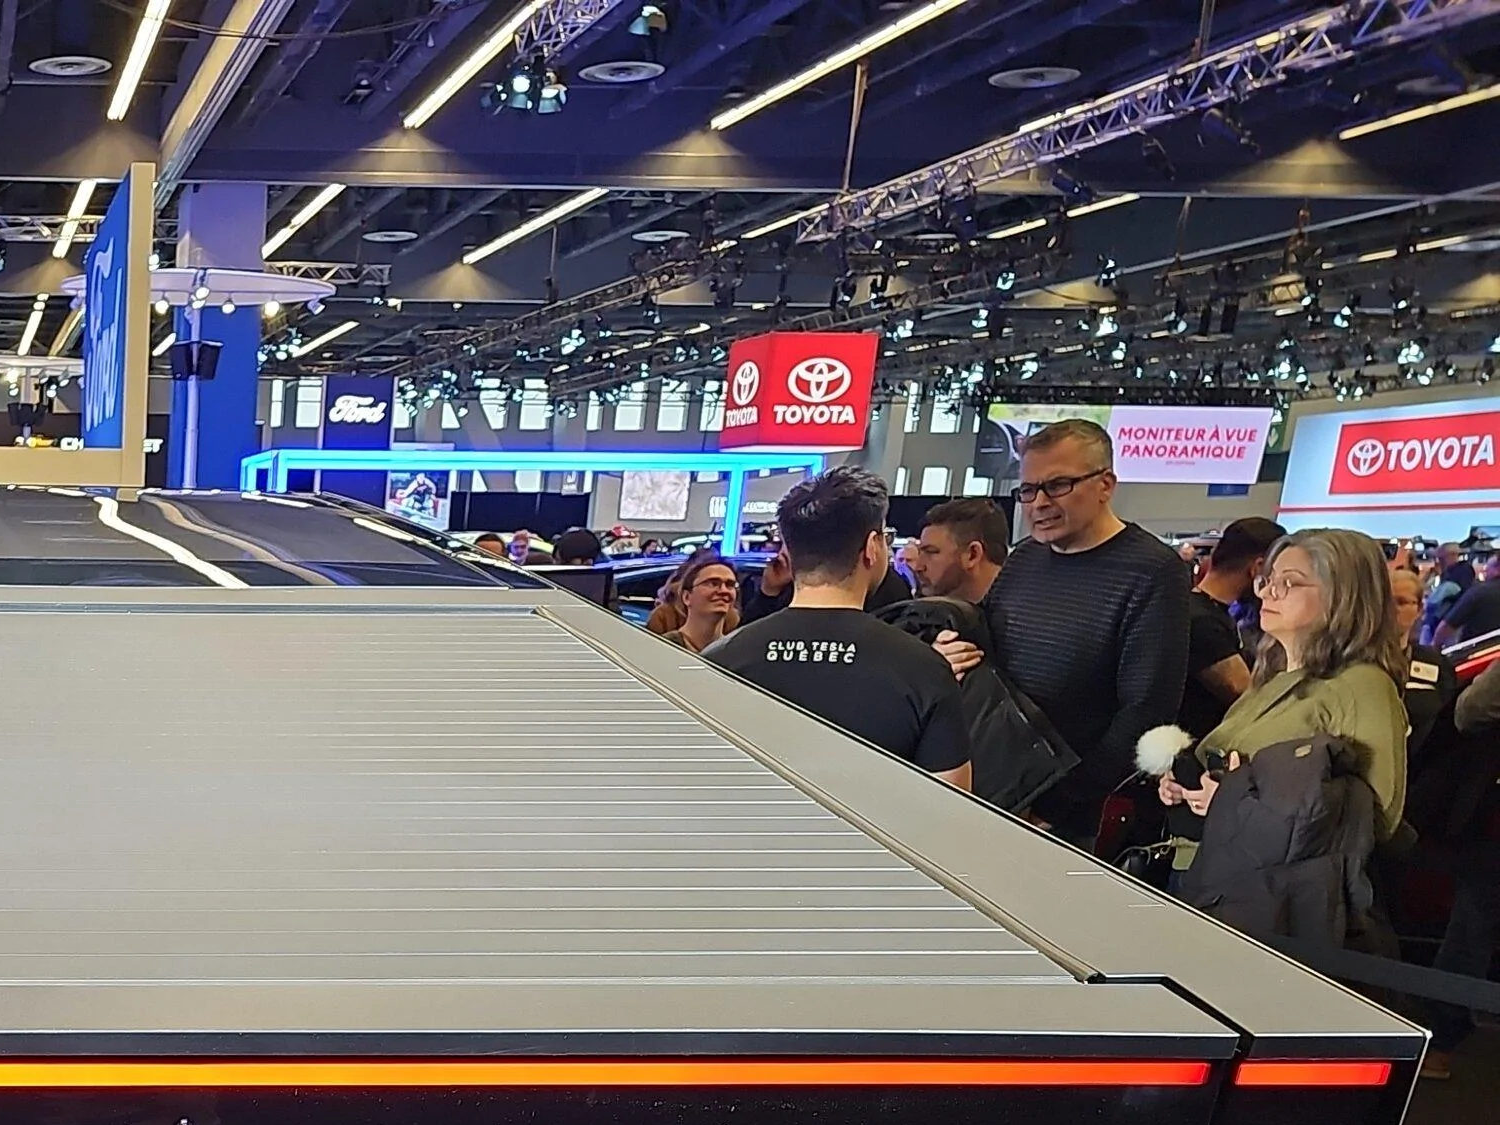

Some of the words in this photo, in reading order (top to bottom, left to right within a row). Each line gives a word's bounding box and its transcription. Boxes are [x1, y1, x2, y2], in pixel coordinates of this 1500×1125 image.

[329, 395, 387, 424] Ford
[726, 406, 758, 428] TOYOTA
[773, 405, 856, 424] TOYOTA
[1118, 427, 1206, 441] MONITEUR
[1208, 425, 1220, 442] À
[1225, 428, 1257, 442] VUE
[1121, 445, 1246, 459] PANORAMIQUE
[1387, 434, 1495, 471] TOYOTA
[766, 648, 855, 663] QUÉBEC
[812, 641, 856, 653] TESLA
